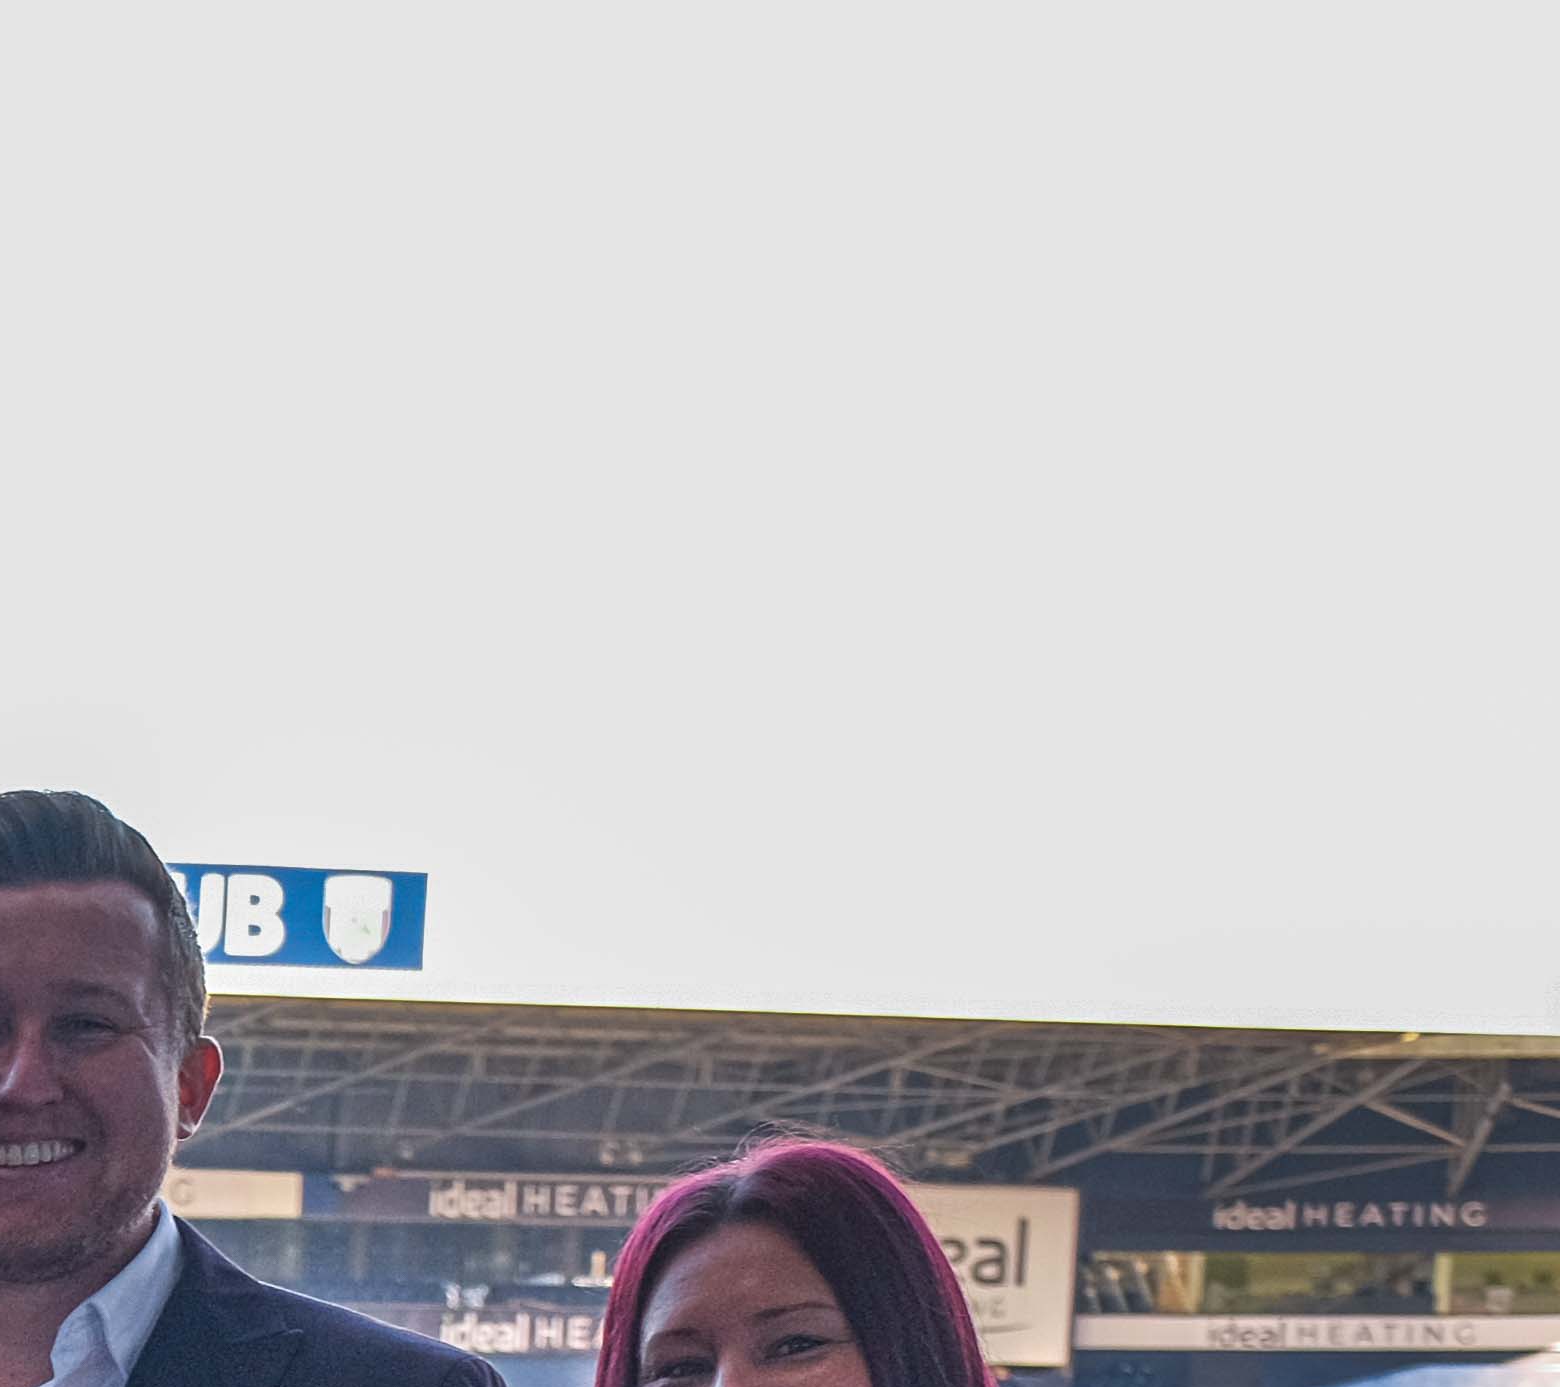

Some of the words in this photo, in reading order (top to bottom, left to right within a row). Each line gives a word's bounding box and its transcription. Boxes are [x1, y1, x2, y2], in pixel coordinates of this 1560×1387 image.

[429, 1180, 517, 1220] ideal
[1212, 1199, 1296, 1230] ideal
[1302, 1201, 1488, 1228] HEATING
[440, 1312, 530, 1353] ideal
[1207, 1316, 1286, 1348] ideal
[1296, 1321, 1478, 1346] HEATING
